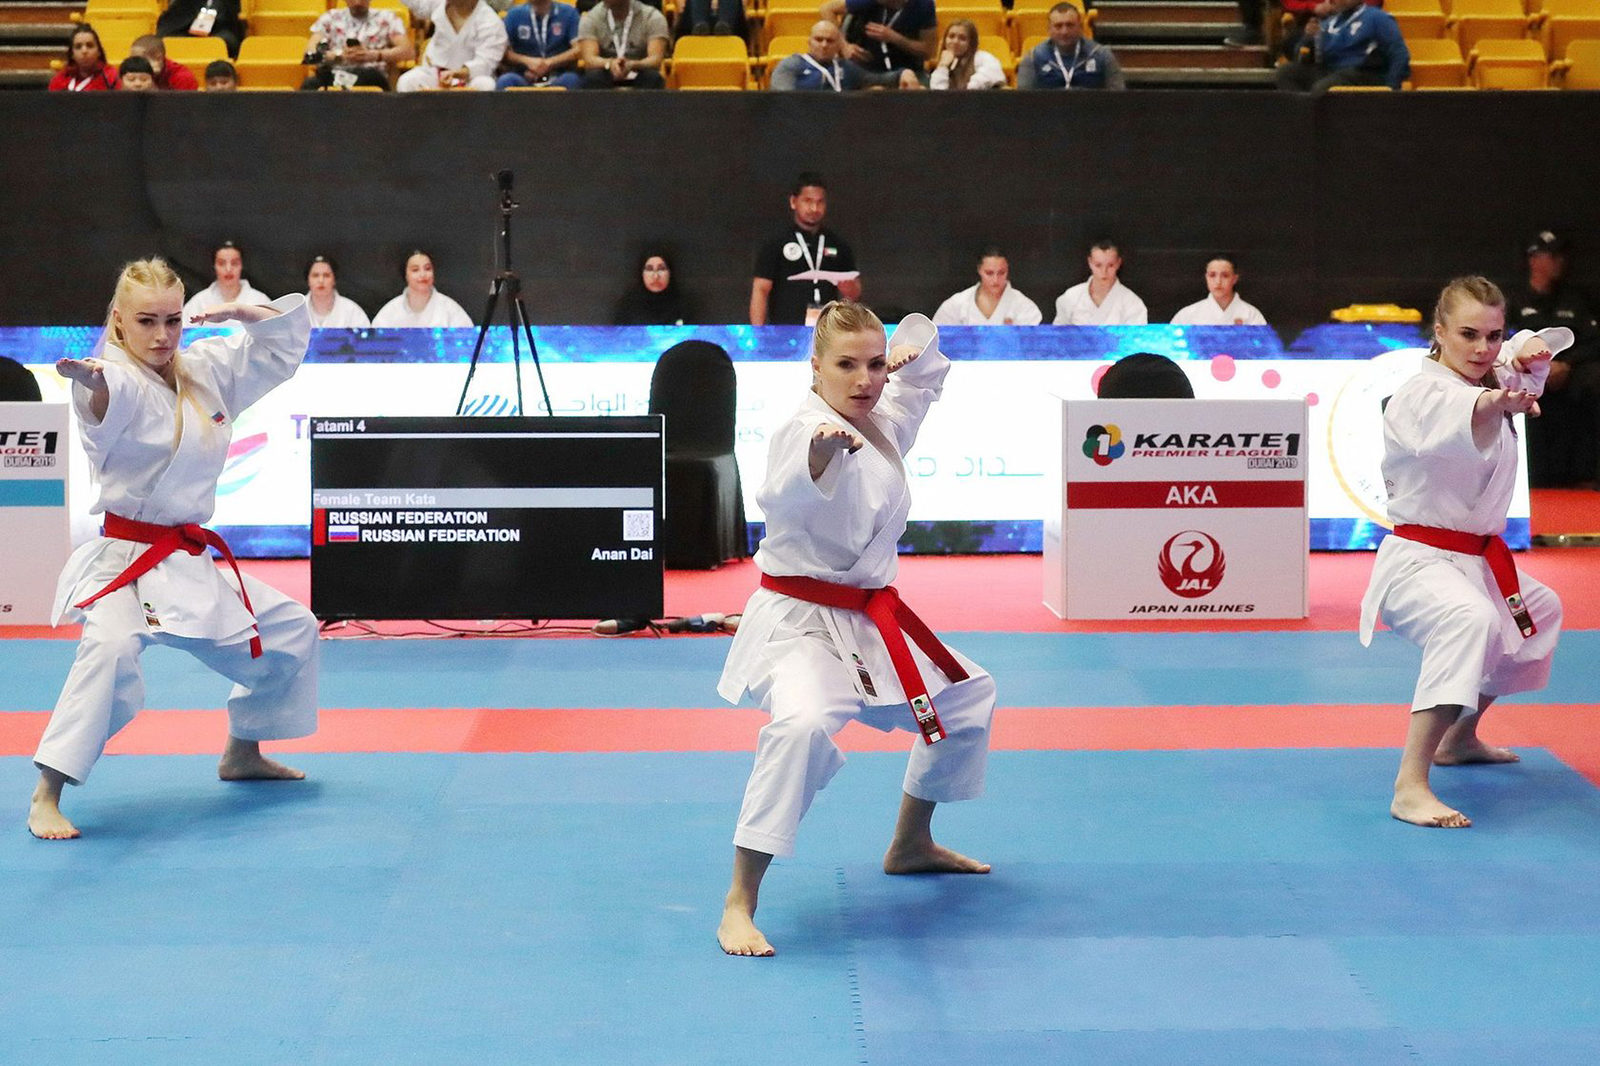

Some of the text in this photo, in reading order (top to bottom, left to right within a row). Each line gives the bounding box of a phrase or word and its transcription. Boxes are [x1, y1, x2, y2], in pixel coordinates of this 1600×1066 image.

[312, 419, 354, 433] atami
[356, 419, 367, 433] 4
[1131, 448, 1284, 458] PREMIER LEAGUE
[1247, 457, 1299, 469] DUBAI 2019
[312, 492, 436, 505] Female Team Kata
[1165, 485, 1219, 505] AKA
[328, 511, 489, 525] RUSSIAN FEDERATION
[361, 528, 521, 542] RUSSIAN FEDERATION
[591, 547, 654, 561] Anan Dai
[1175, 578, 1213, 591] JAL
[1128, 604, 1256, 614] JAPAN AIRLINES
